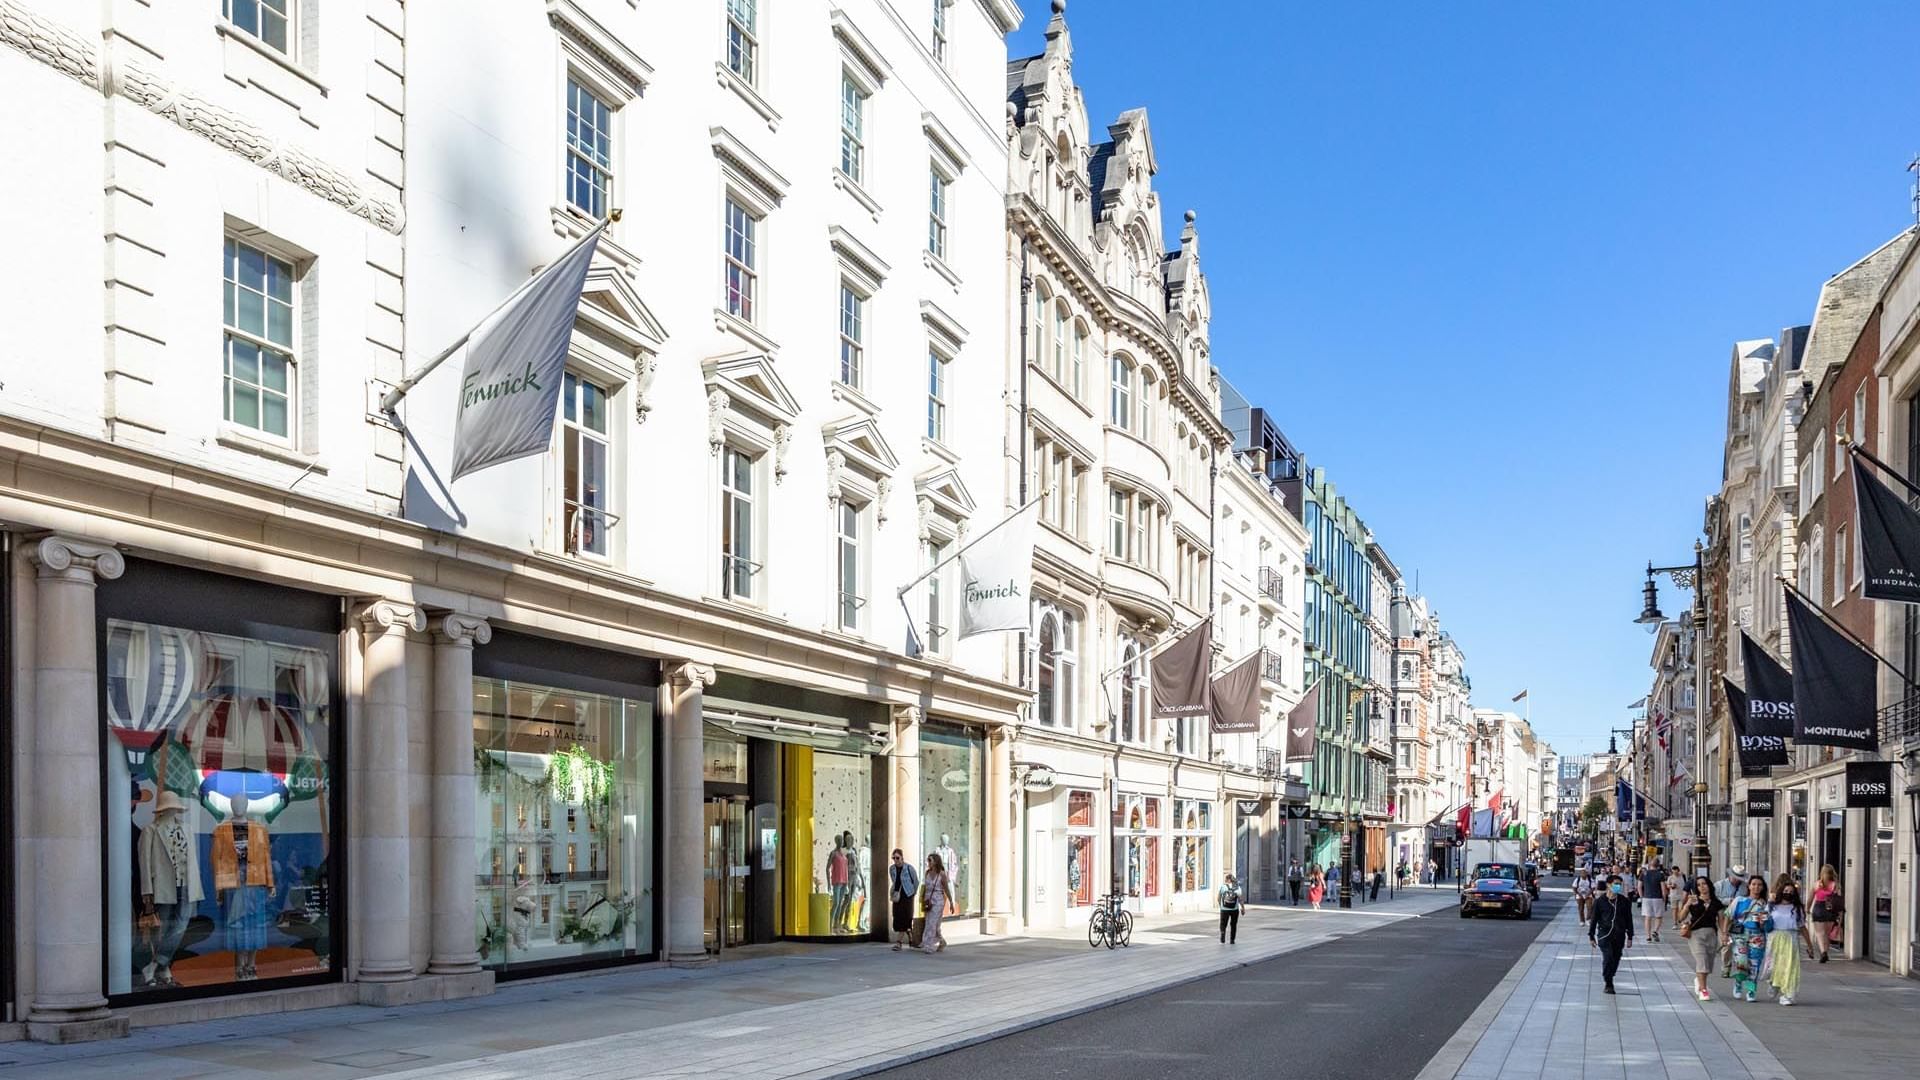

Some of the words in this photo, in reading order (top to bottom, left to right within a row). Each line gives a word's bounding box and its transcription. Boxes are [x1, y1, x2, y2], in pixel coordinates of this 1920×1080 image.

[460, 361, 542, 421] Fenwick
[1888, 568, 1915, 578] ANA
[964, 579, 1021, 609] Fenwick
[1804, 726, 1866, 739] MONTBLANC
[1740, 735, 1783, 748] BOSS
[1852, 782, 1886, 792] BOSS
